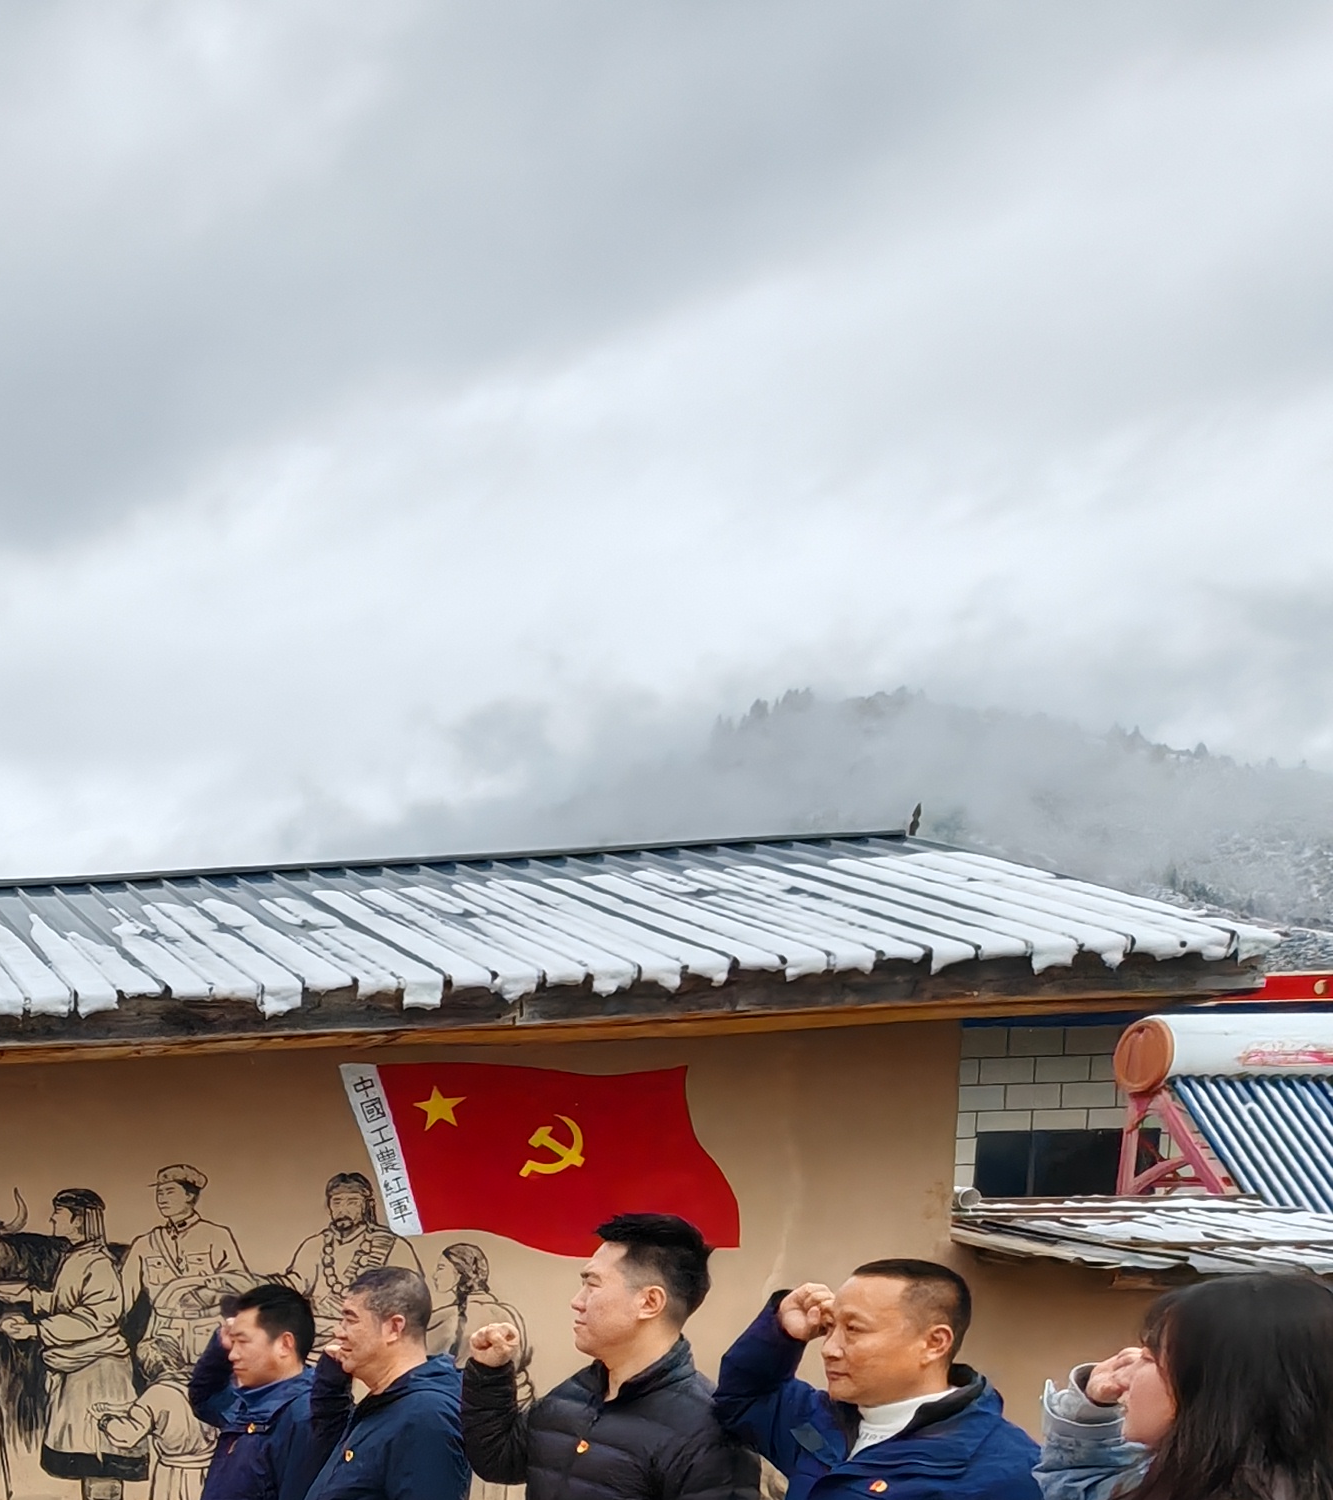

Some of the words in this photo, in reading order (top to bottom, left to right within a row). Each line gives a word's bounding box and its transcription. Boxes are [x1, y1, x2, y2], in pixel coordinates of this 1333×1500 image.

[352, 1075, 413, 1224] 中國工農紅軍
